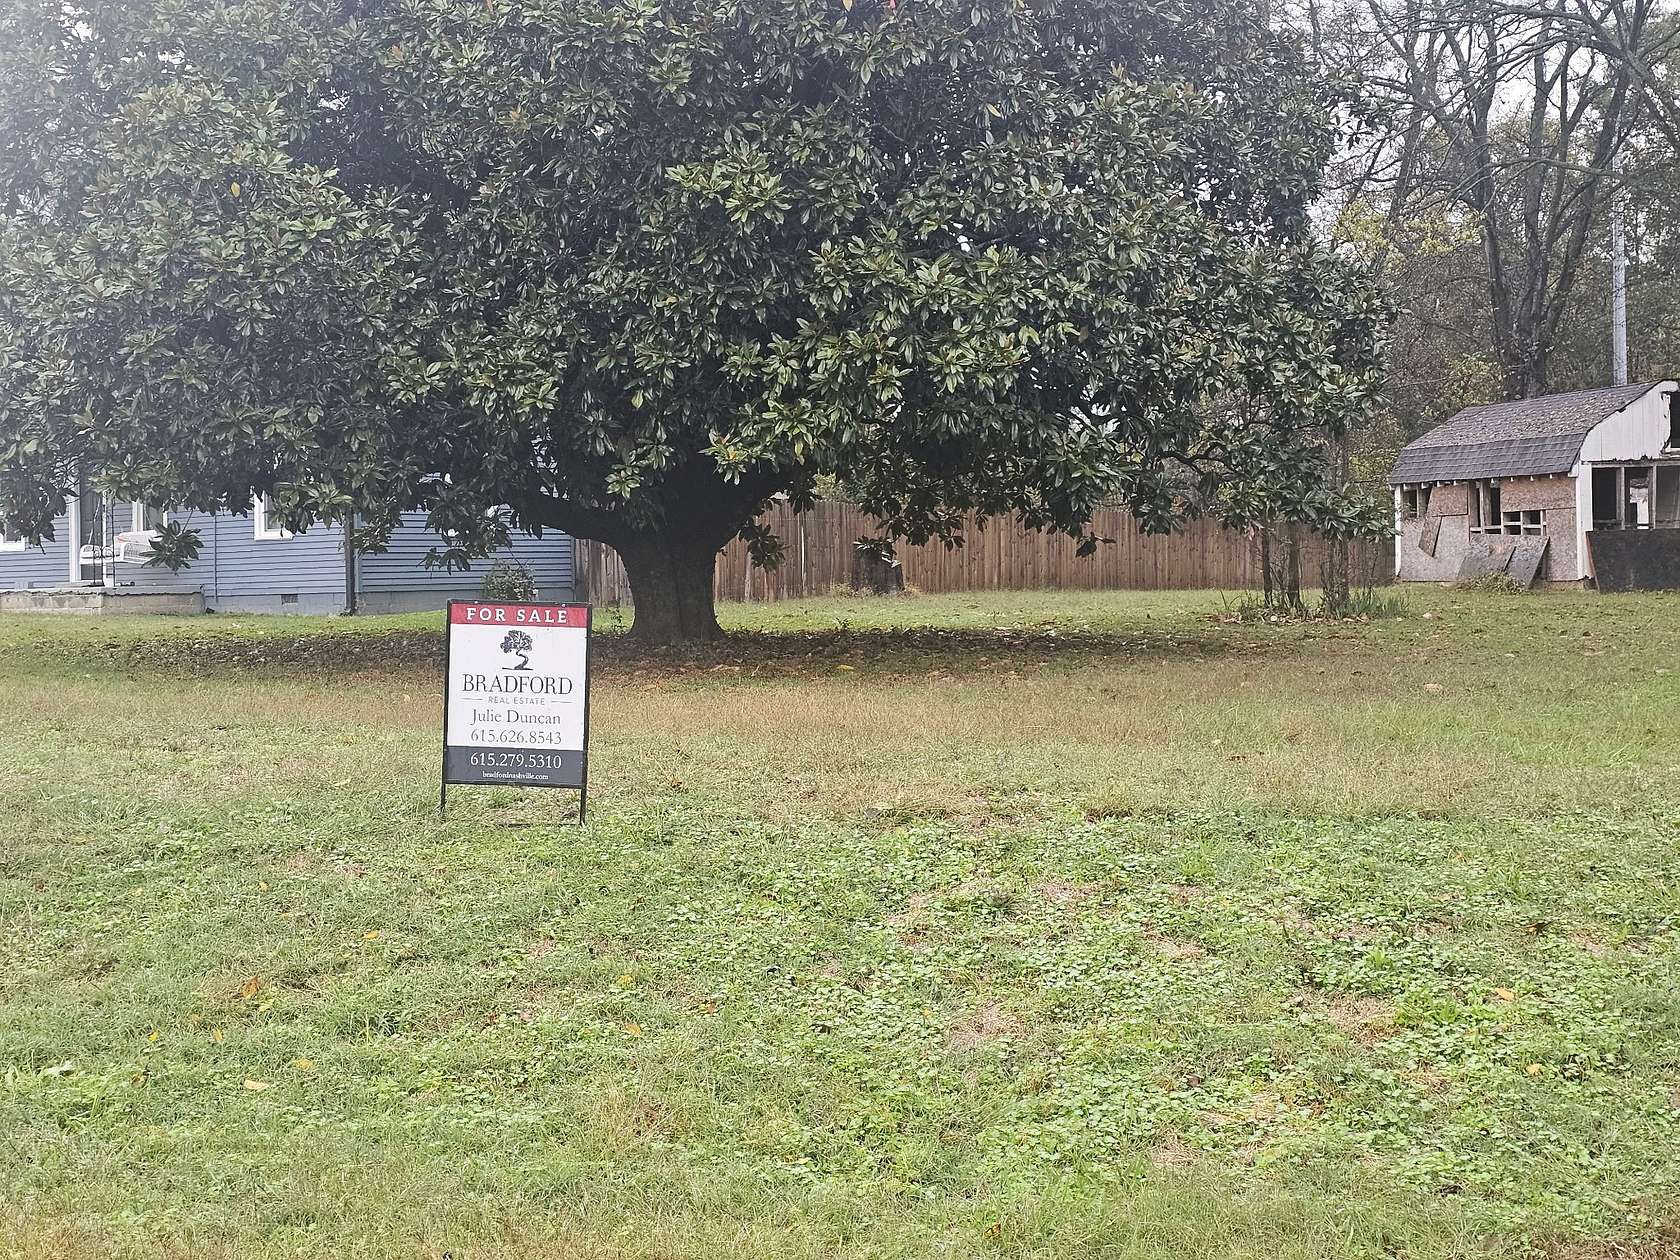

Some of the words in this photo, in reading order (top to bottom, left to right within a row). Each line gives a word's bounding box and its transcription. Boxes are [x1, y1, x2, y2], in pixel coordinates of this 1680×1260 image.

[466, 607, 506, 622] FOR
[516, 609, 568, 623] SALE
[462, 673, 573, 695] BRADFORD
[488, 696, 510, 704] REAL
[514, 697, 545, 706] ESTATE
[470, 708, 502, 726] Julie
[506, 709, 561, 725] Duncan
[470, 729, 562, 745] 615.626.8543
[470, 752, 562, 769] 615.279.5310
[482, 770, 549, 781] bradfordnashville.com
